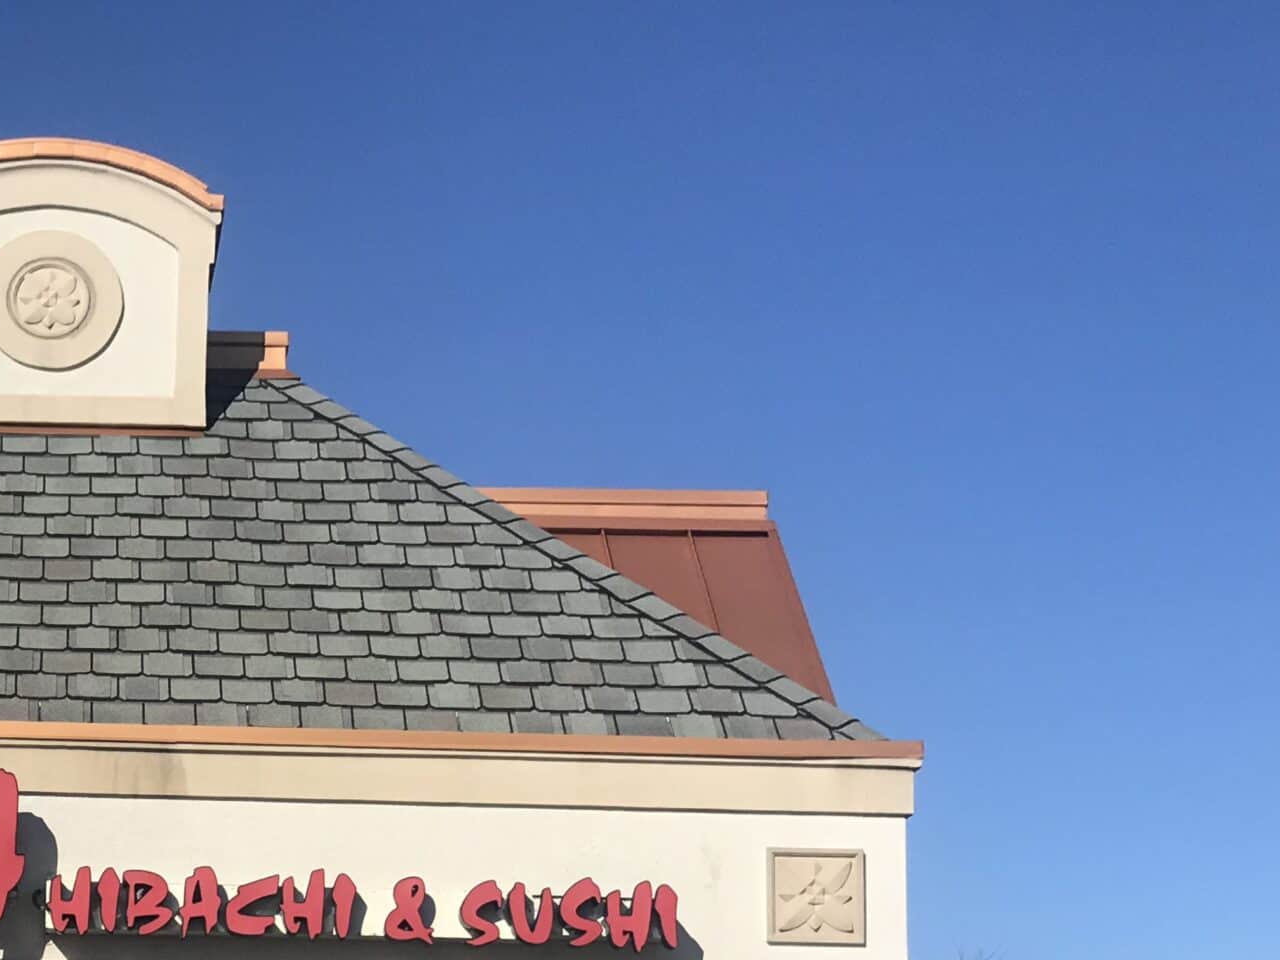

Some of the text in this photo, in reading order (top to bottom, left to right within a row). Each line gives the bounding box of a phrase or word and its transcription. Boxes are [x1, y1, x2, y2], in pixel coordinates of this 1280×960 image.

[47, 865, 679, 952] HIBACHI & SUSHI
